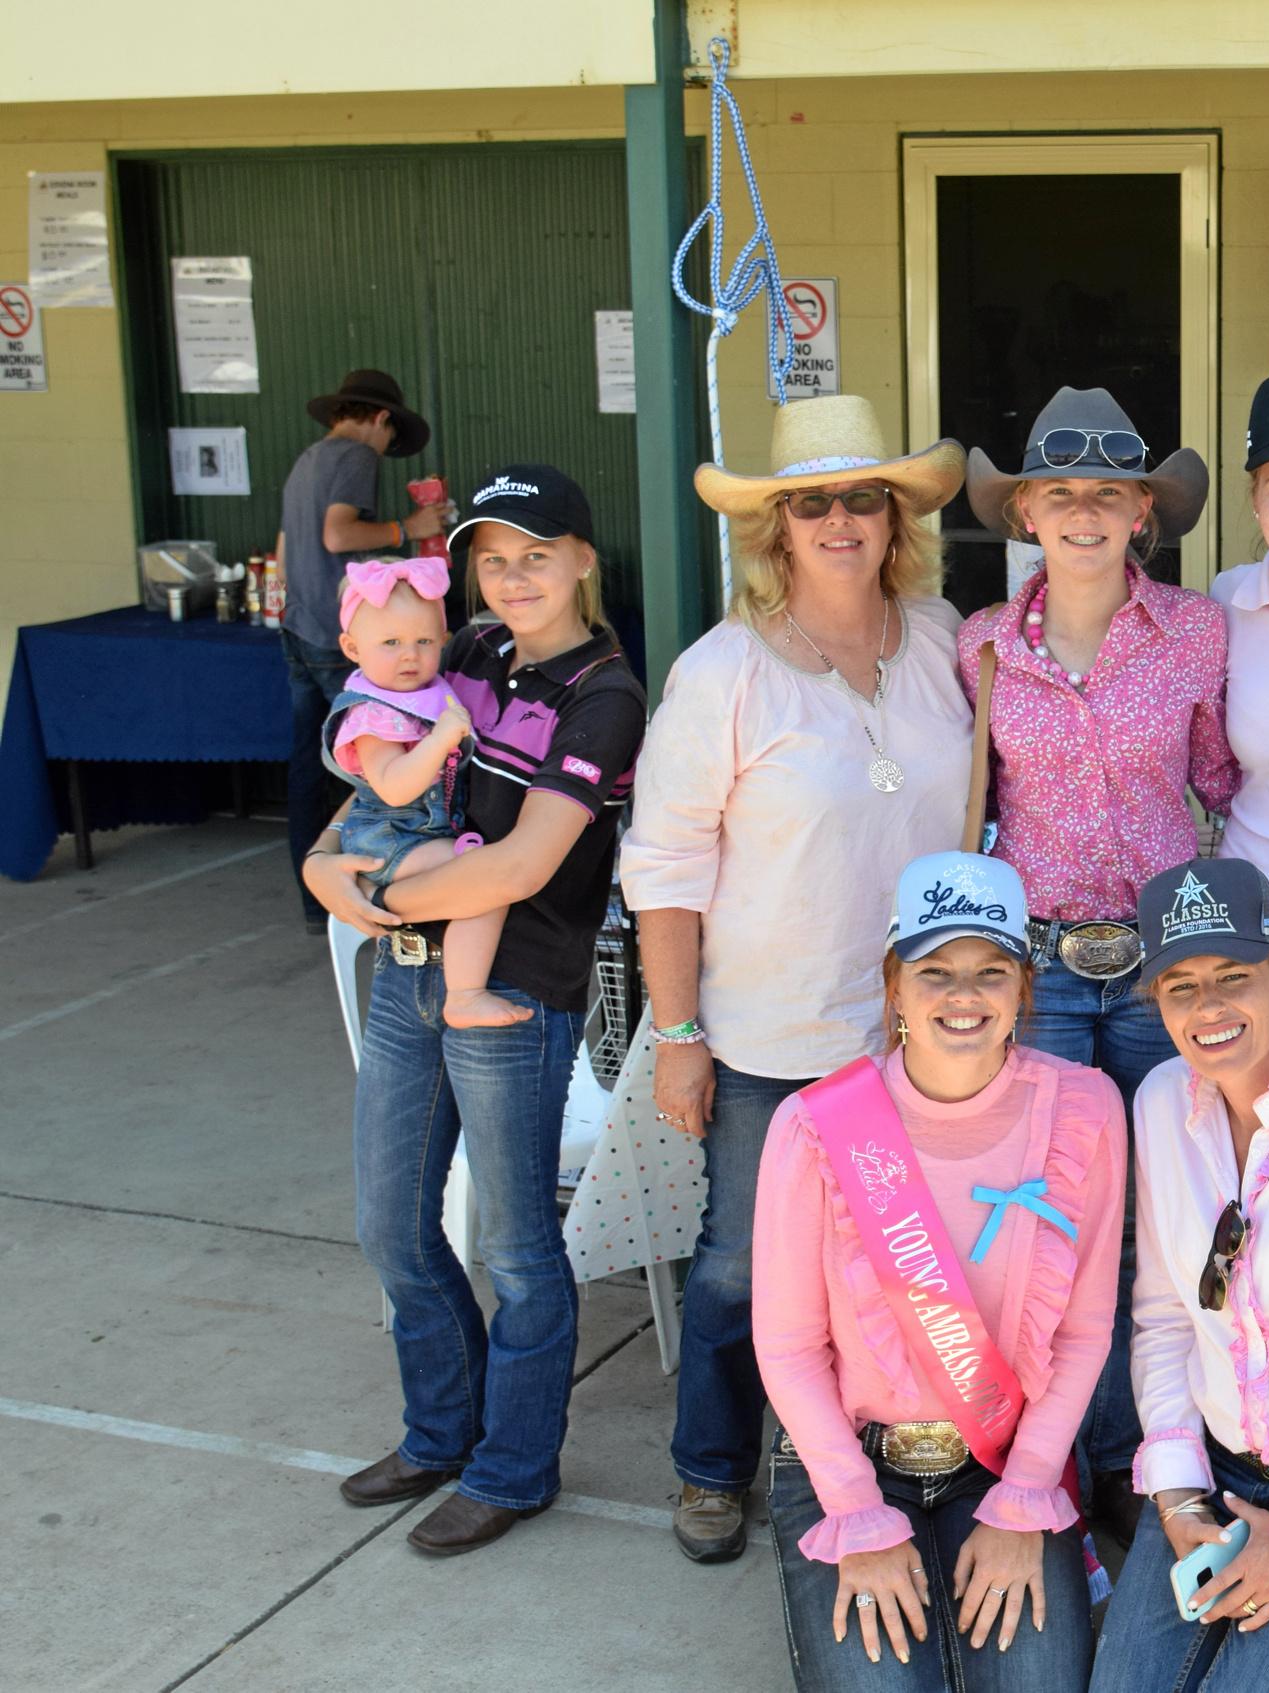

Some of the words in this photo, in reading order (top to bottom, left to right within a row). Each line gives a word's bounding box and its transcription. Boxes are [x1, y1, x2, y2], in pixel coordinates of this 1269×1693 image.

[8, 341, 24, 352] NO
[794, 343, 812, 356] NO
[0, 354, 43, 366] MOKING
[4, 367, 33, 380] AREA
[784, 374, 822, 387] AREA
[918, 880, 1008, 925] Ladies
[1161, 903, 1229, 929] CLASSIC
[1186, 917, 1226, 928] FOUNDATION
[880, 1210, 950, 1302] YOUNG
